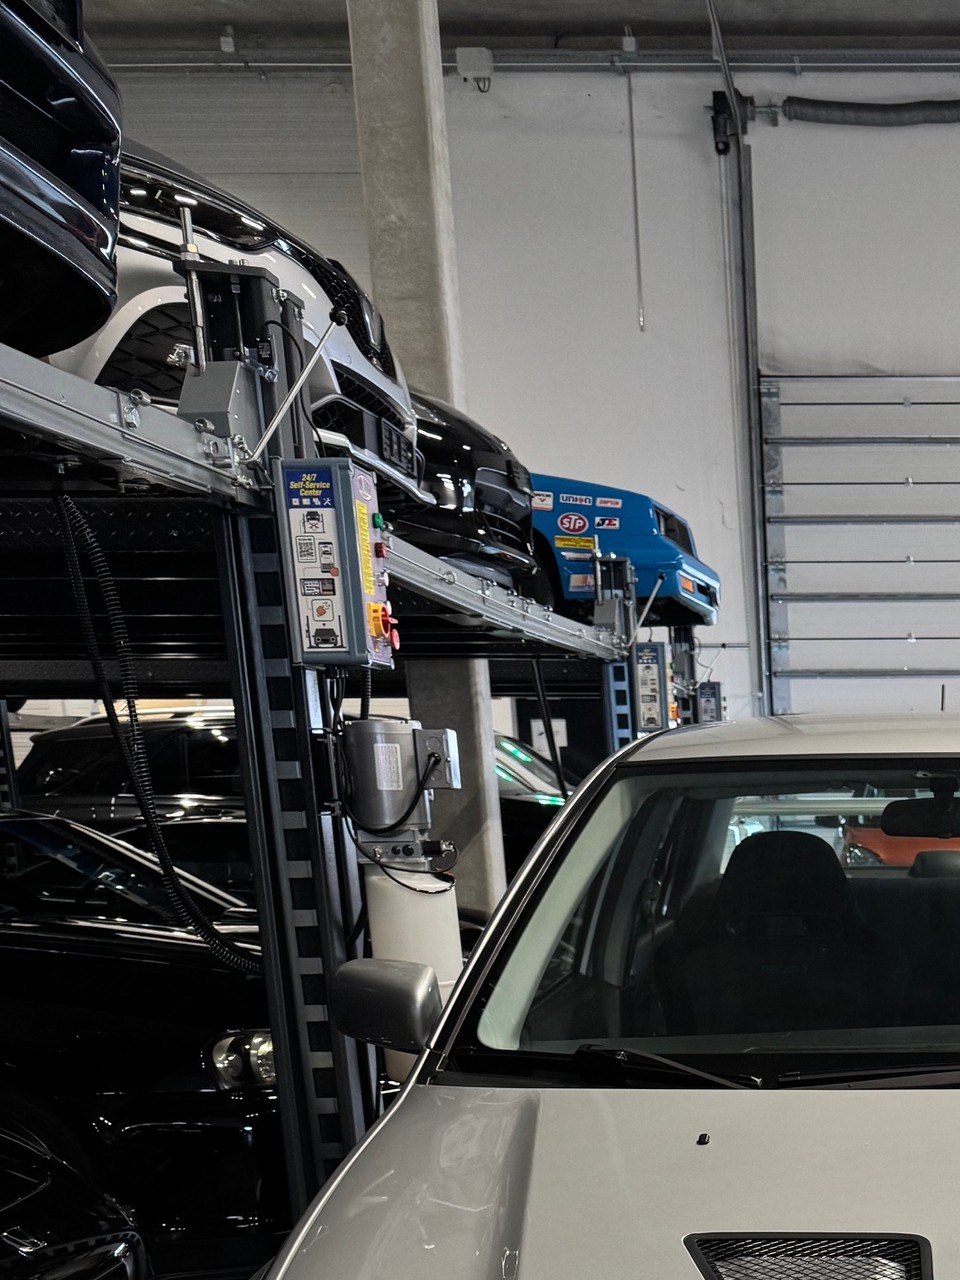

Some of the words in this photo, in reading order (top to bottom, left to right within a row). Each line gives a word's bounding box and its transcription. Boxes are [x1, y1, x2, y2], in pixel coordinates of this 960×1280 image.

[301, 473, 317, 481] 24/7
[289, 481, 331, 489] Self-Service
[299, 488, 323, 496] Center
[562, 514, 584, 530] STP
